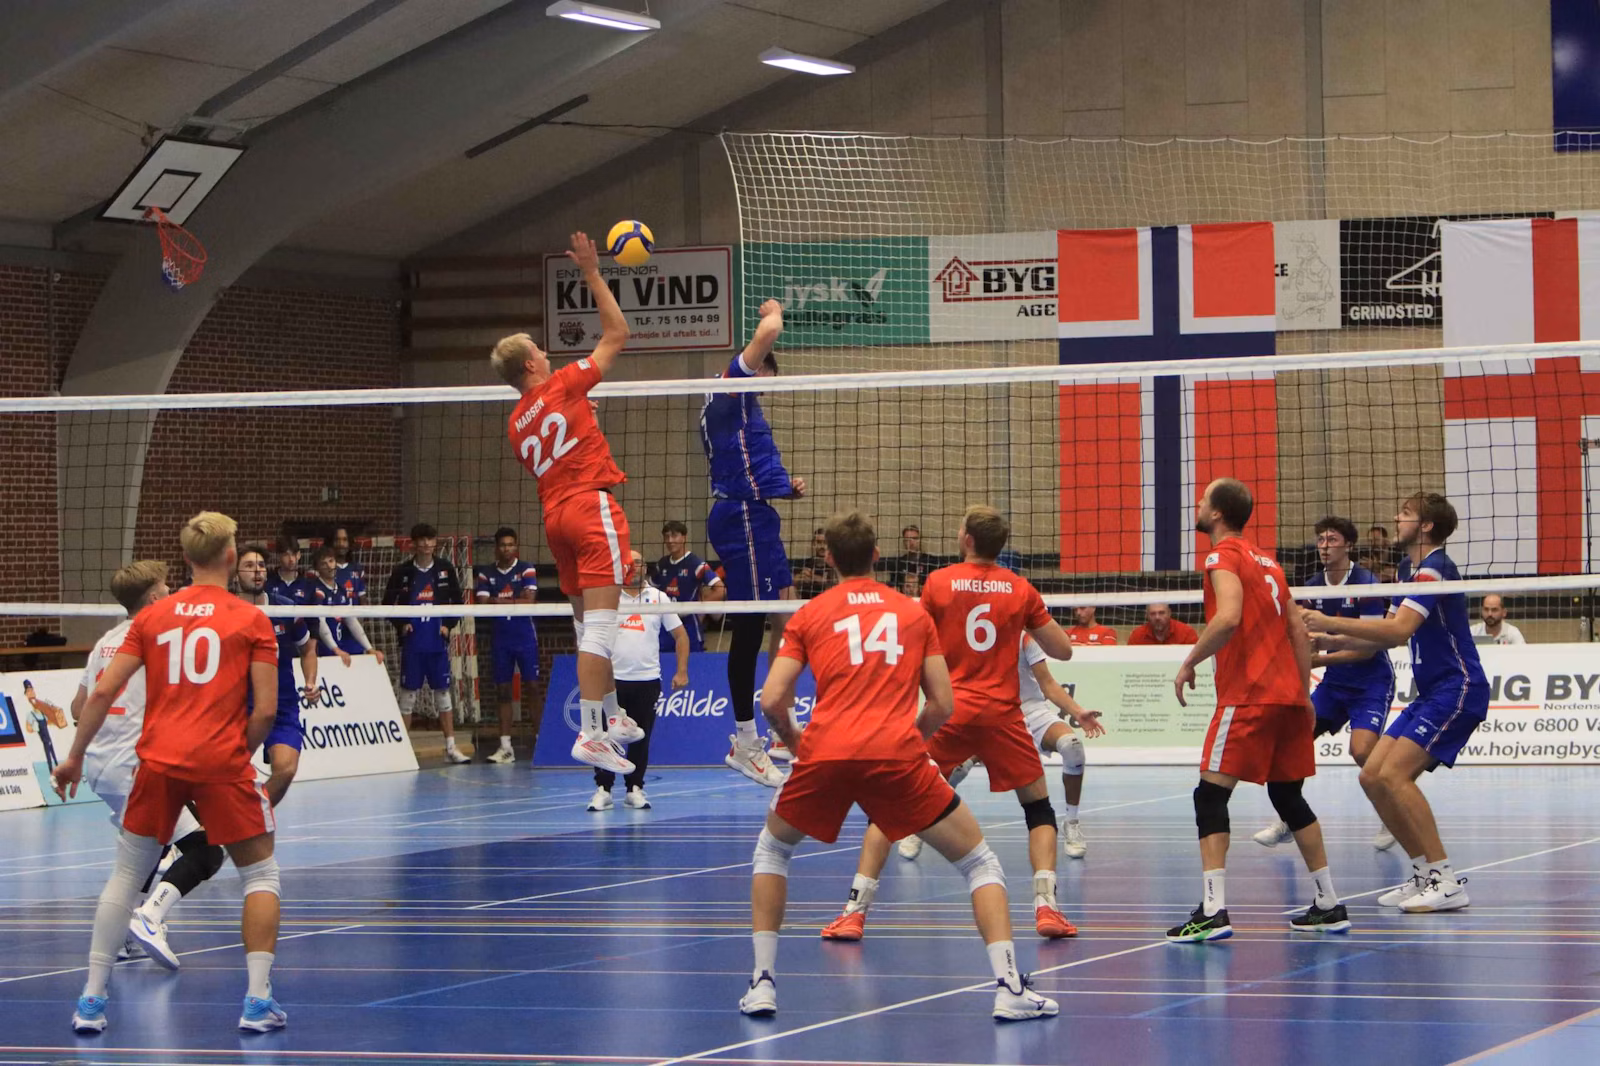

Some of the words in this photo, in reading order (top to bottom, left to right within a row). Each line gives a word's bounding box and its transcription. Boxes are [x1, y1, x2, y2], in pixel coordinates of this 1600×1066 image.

[556, 265, 659, 279] ENTPRENØR
[983, 267, 1055, 293] BYG
[783, 276, 849, 310] jysk
[635, 316, 654, 325] TLF.
[658, 316, 671, 325] 75
[690, 314, 703, 323] 94
[707, 314, 720, 323] 99
[1350, 304, 1434, 320] GRINDSTED
[515, 397, 545, 432] MADSEN
[521, 412, 579, 477] 22
[847, 592, 884, 604] DAHL
[951, 579, 1012, 593] MIKELSONS
[174, 602, 215, 616] KJÆR
[833, 612, 904, 665] 14
[965, 603, 997, 652] 6
[156, 626, 221, 685] 10
[1545, 674, 1600, 700] BY
[654, 690, 728, 717] kilde
[301, 718, 403, 751] Kommune
[1534, 718, 1579, 732] 6800
[1320, 743, 1343, 757] 35
